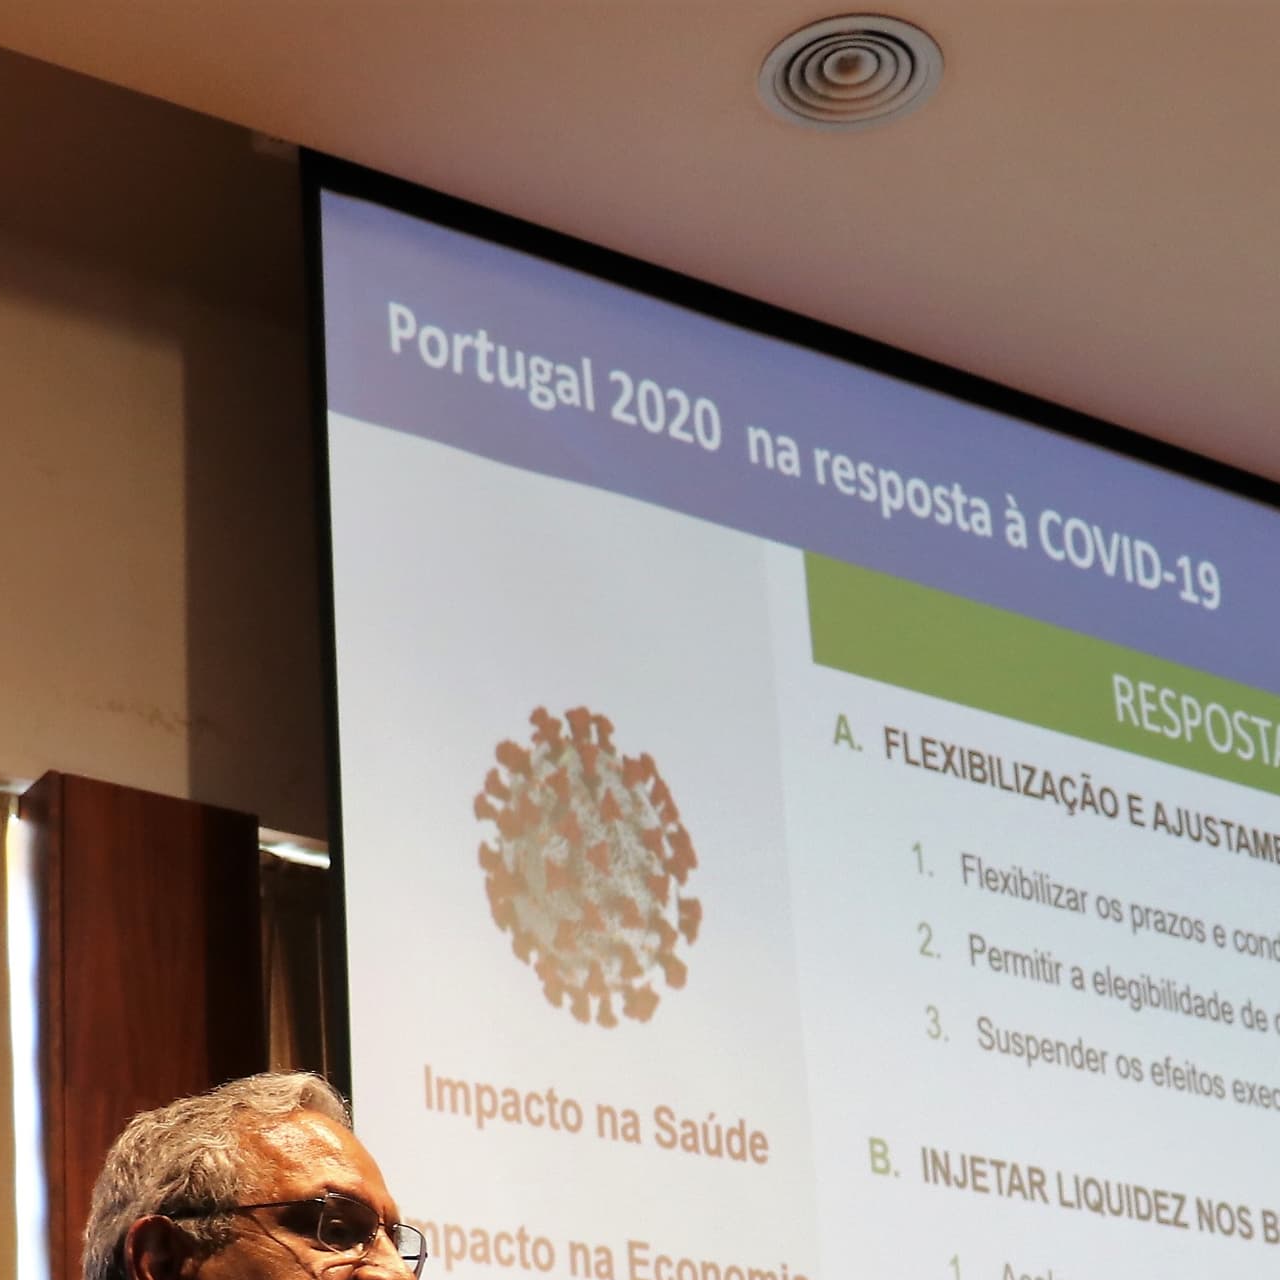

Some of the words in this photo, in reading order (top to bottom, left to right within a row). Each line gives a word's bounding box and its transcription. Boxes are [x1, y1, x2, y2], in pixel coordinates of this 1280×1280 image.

[388, 301, 595, 411] Portugal
[608, 370, 721, 451] 2020
[747, 425, 800, 478] na
[814, 447, 992, 538] resposta
[1005, 494, 1027, 550] à
[1039, 509, 1220, 610] COVID-19
[833, 713, 863, 752] A.
[884, 725, 1118, 817] FLEXIBILIZAÇÃO
[1127, 793, 1146, 827] E
[912, 841, 934, 878] 1.
[962, 852, 1088, 915] Flexibilizar
[1096, 893, 1123, 923] os
[1130, 903, 1206, 944] prazos
[1213, 922, 1227, 948] e
[917, 922, 941, 960] 2.
[969, 932, 1062, 986] Permitir
[1070, 965, 1085, 992] a
[1093, 967, 1234, 1025] elegibilidade
[1241, 1000, 1269, 1033] de
[925, 1004, 949, 1043] 3.
[977, 1015, 1109, 1075] Suspender
[1116, 1052, 1144, 1083] os
[1150, 1056, 1227, 1100] efeitos
[423, 1064, 583, 1134] Impacto
[596, 1103, 642, 1145] na
[653, 1104, 769, 1165] Saúde
[868, 1136, 900, 1178] B.
[921, 1146, 1050, 1204] INJETAR
[1056, 1171, 1190, 1230] LIQUIDEZ
[1196, 1197, 1254, 1241] NOS
[403, 1215, 556, 1272] mpacto
